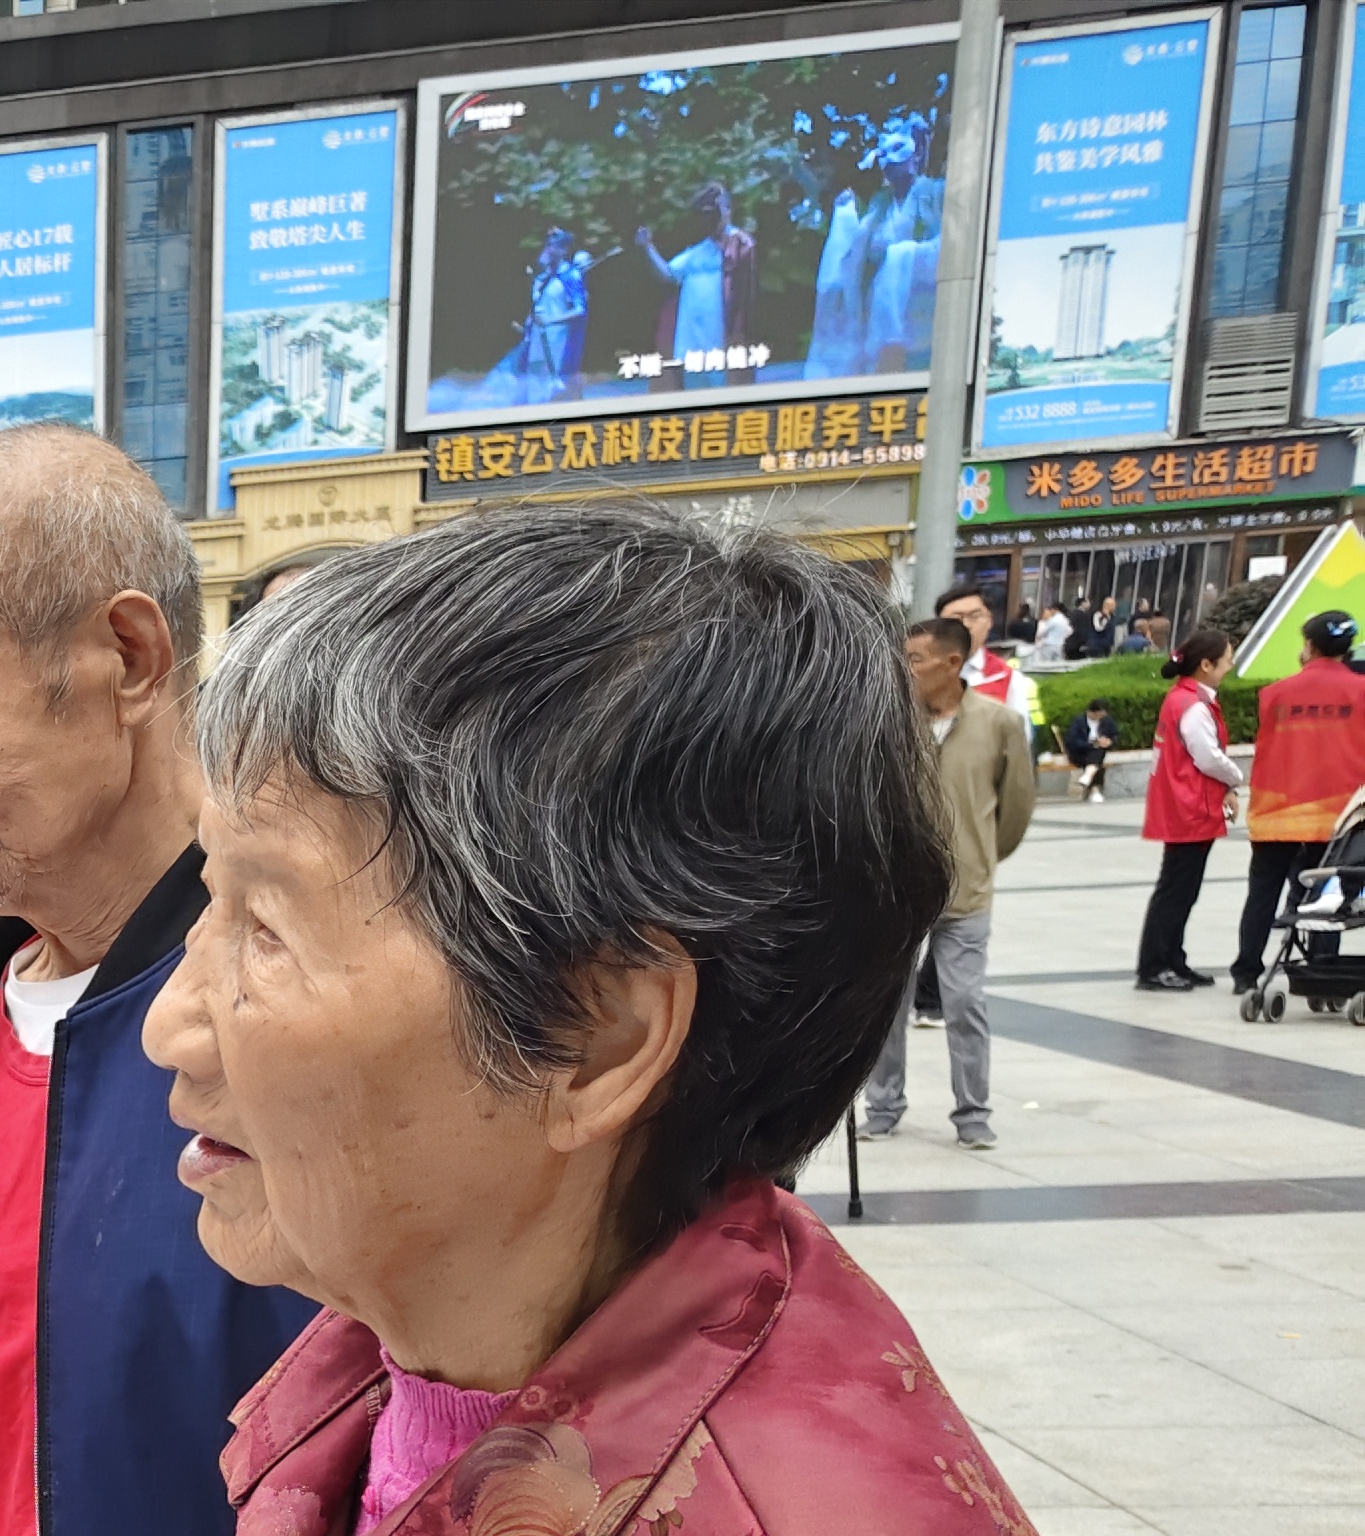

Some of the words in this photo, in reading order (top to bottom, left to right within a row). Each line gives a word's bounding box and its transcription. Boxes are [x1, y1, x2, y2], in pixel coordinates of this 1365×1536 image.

[1027, 441, 1319, 499] 米多多生活超市
[1060, 493, 1103, 510] MIDO
[1112, 490, 1145, 506] LIFE
[1155, 480, 1277, 503] SUPERMARKET
